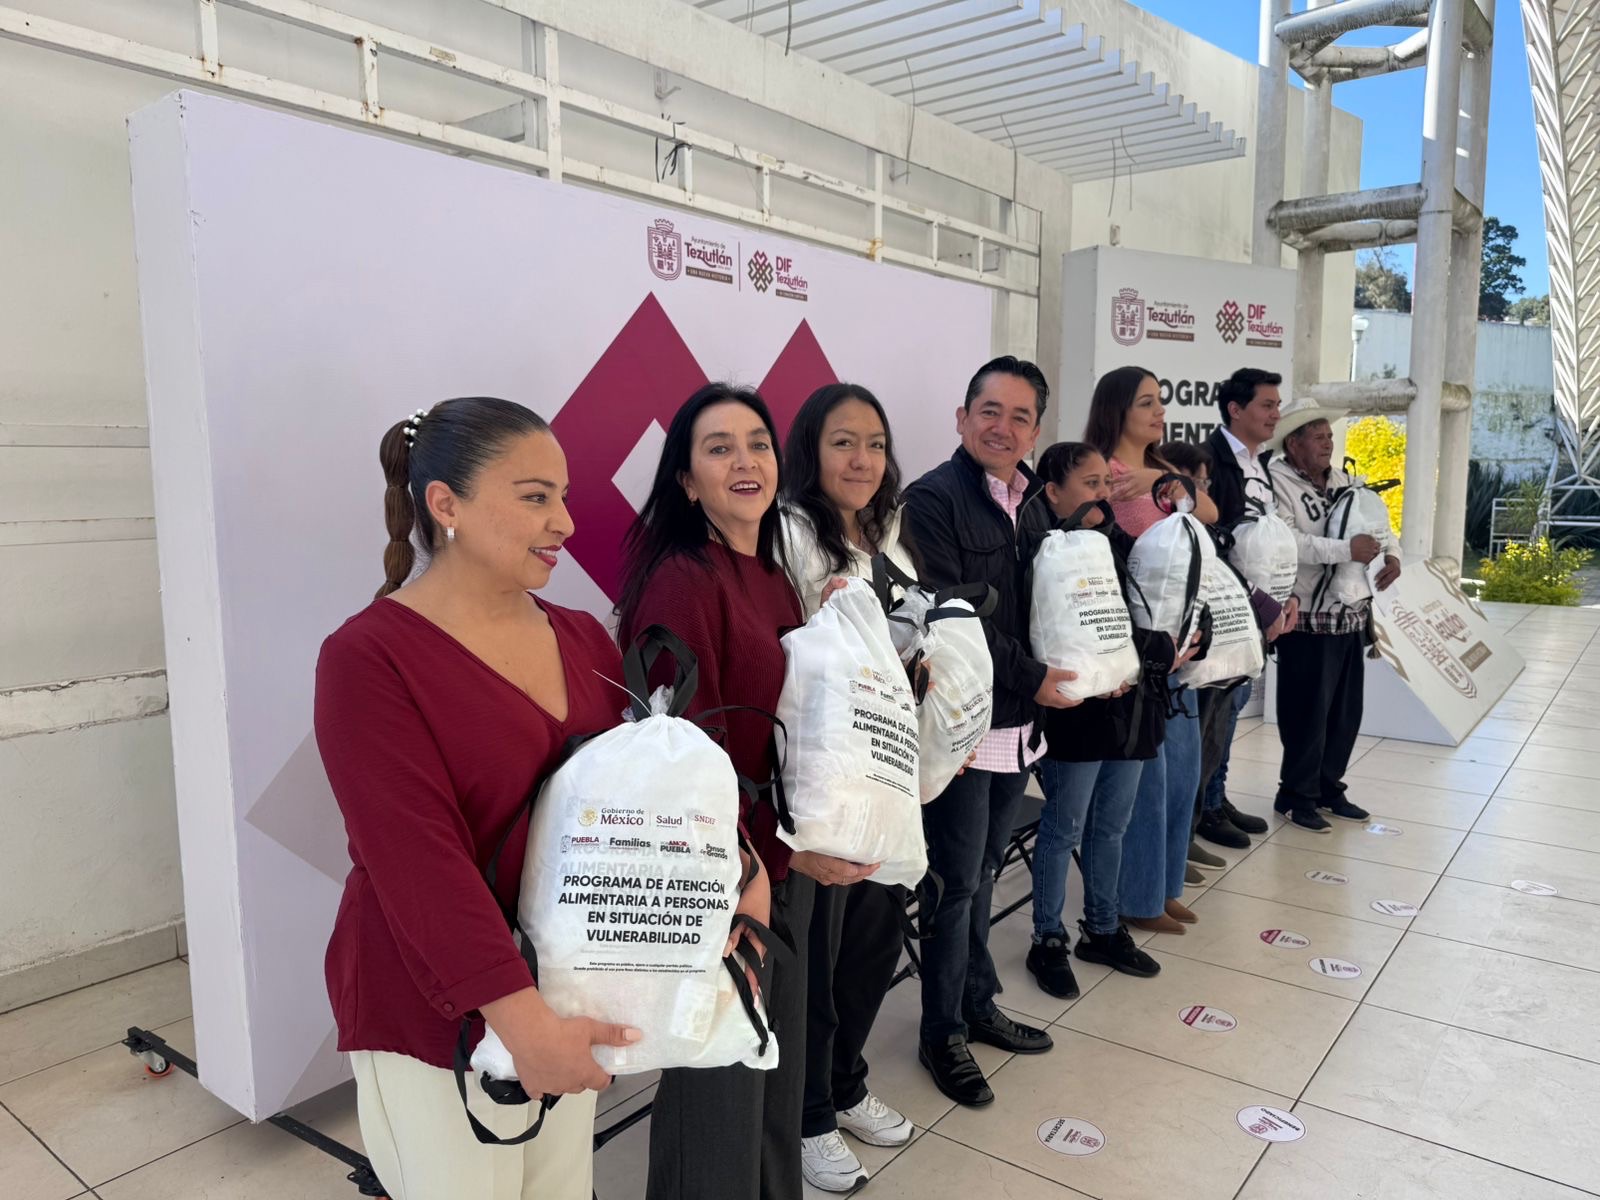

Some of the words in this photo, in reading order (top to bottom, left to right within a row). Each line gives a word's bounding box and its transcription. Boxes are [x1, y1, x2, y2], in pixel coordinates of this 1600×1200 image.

[684, 242, 733, 268] Teziutlán
[776, 256, 792, 273] DIF
[775, 272, 808, 290] Teziutlán
[1146, 307, 1195, 328] Teziutlán
[1248, 304, 1266, 320] DIF
[1247, 320, 1283, 337] Teziutlán
[1159, 379, 1221, 406] OGRA
[854, 708, 897, 729] PROGRAMA
[852, 720, 899, 742] ALIMENTARIA
[871, 737, 880, 748] EN
[600, 813, 644, 826] México
[656, 815, 682, 825] Salud
[601, 807, 635, 815] Gobierno
[571, 836, 600, 844] PUEBLA
[609, 837, 652, 848] Familias
[660, 845, 691, 854] PUEBLA
[563, 875, 642, 889] PROGRAMA
[646, 879, 663, 890] DE
[666, 878, 725, 894] ATENCIÓN
[558, 892, 648, 907] ALIMENTARIA
[651, 896, 661, 908] A
[664, 897, 729, 911] PERSONAS
[587, 911, 606, 924] EN
[609, 911, 682, 926] SITUACIÓN
[685, 915, 703, 927] DE
[586, 929, 701, 945] VULNERABILIDAD
